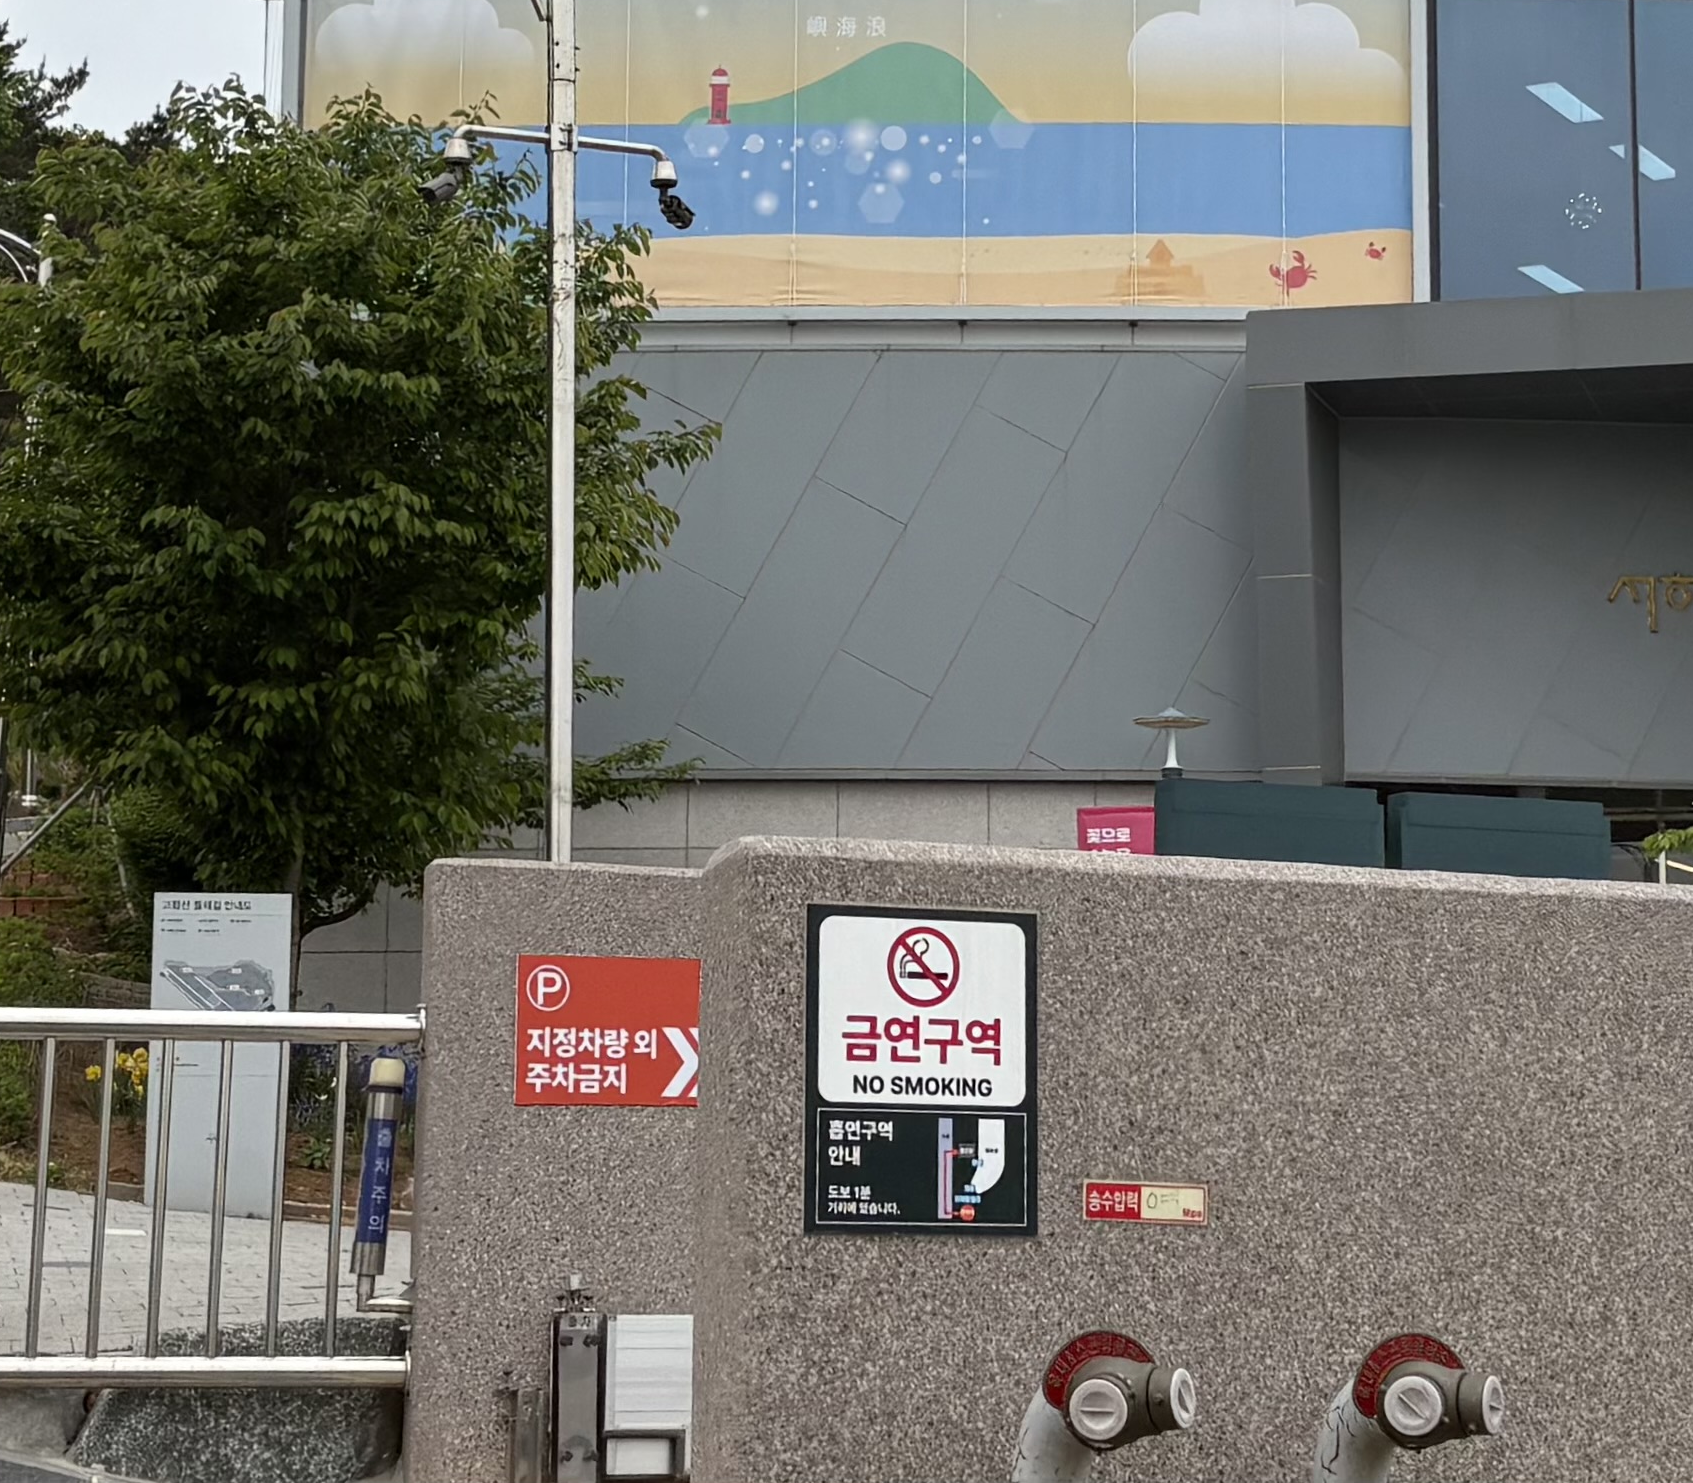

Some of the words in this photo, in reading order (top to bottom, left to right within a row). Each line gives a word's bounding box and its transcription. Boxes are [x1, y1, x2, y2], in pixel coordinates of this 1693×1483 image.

[526, 1026, 630, 1059] 지정차량
[633, 1028, 658, 1060] 외
[841, 1015, 1001, 1066] 금연구역
[525, 1062, 628, 1095] 주차금지
[853, 1074, 885, 1094] NO
[890, 1076, 993, 1098] SMOKING
[828, 1119, 894, 1142] 흡연구역
[827, 1144, 861, 1166] 안내
[827, 1184, 852, 1199] 도보
